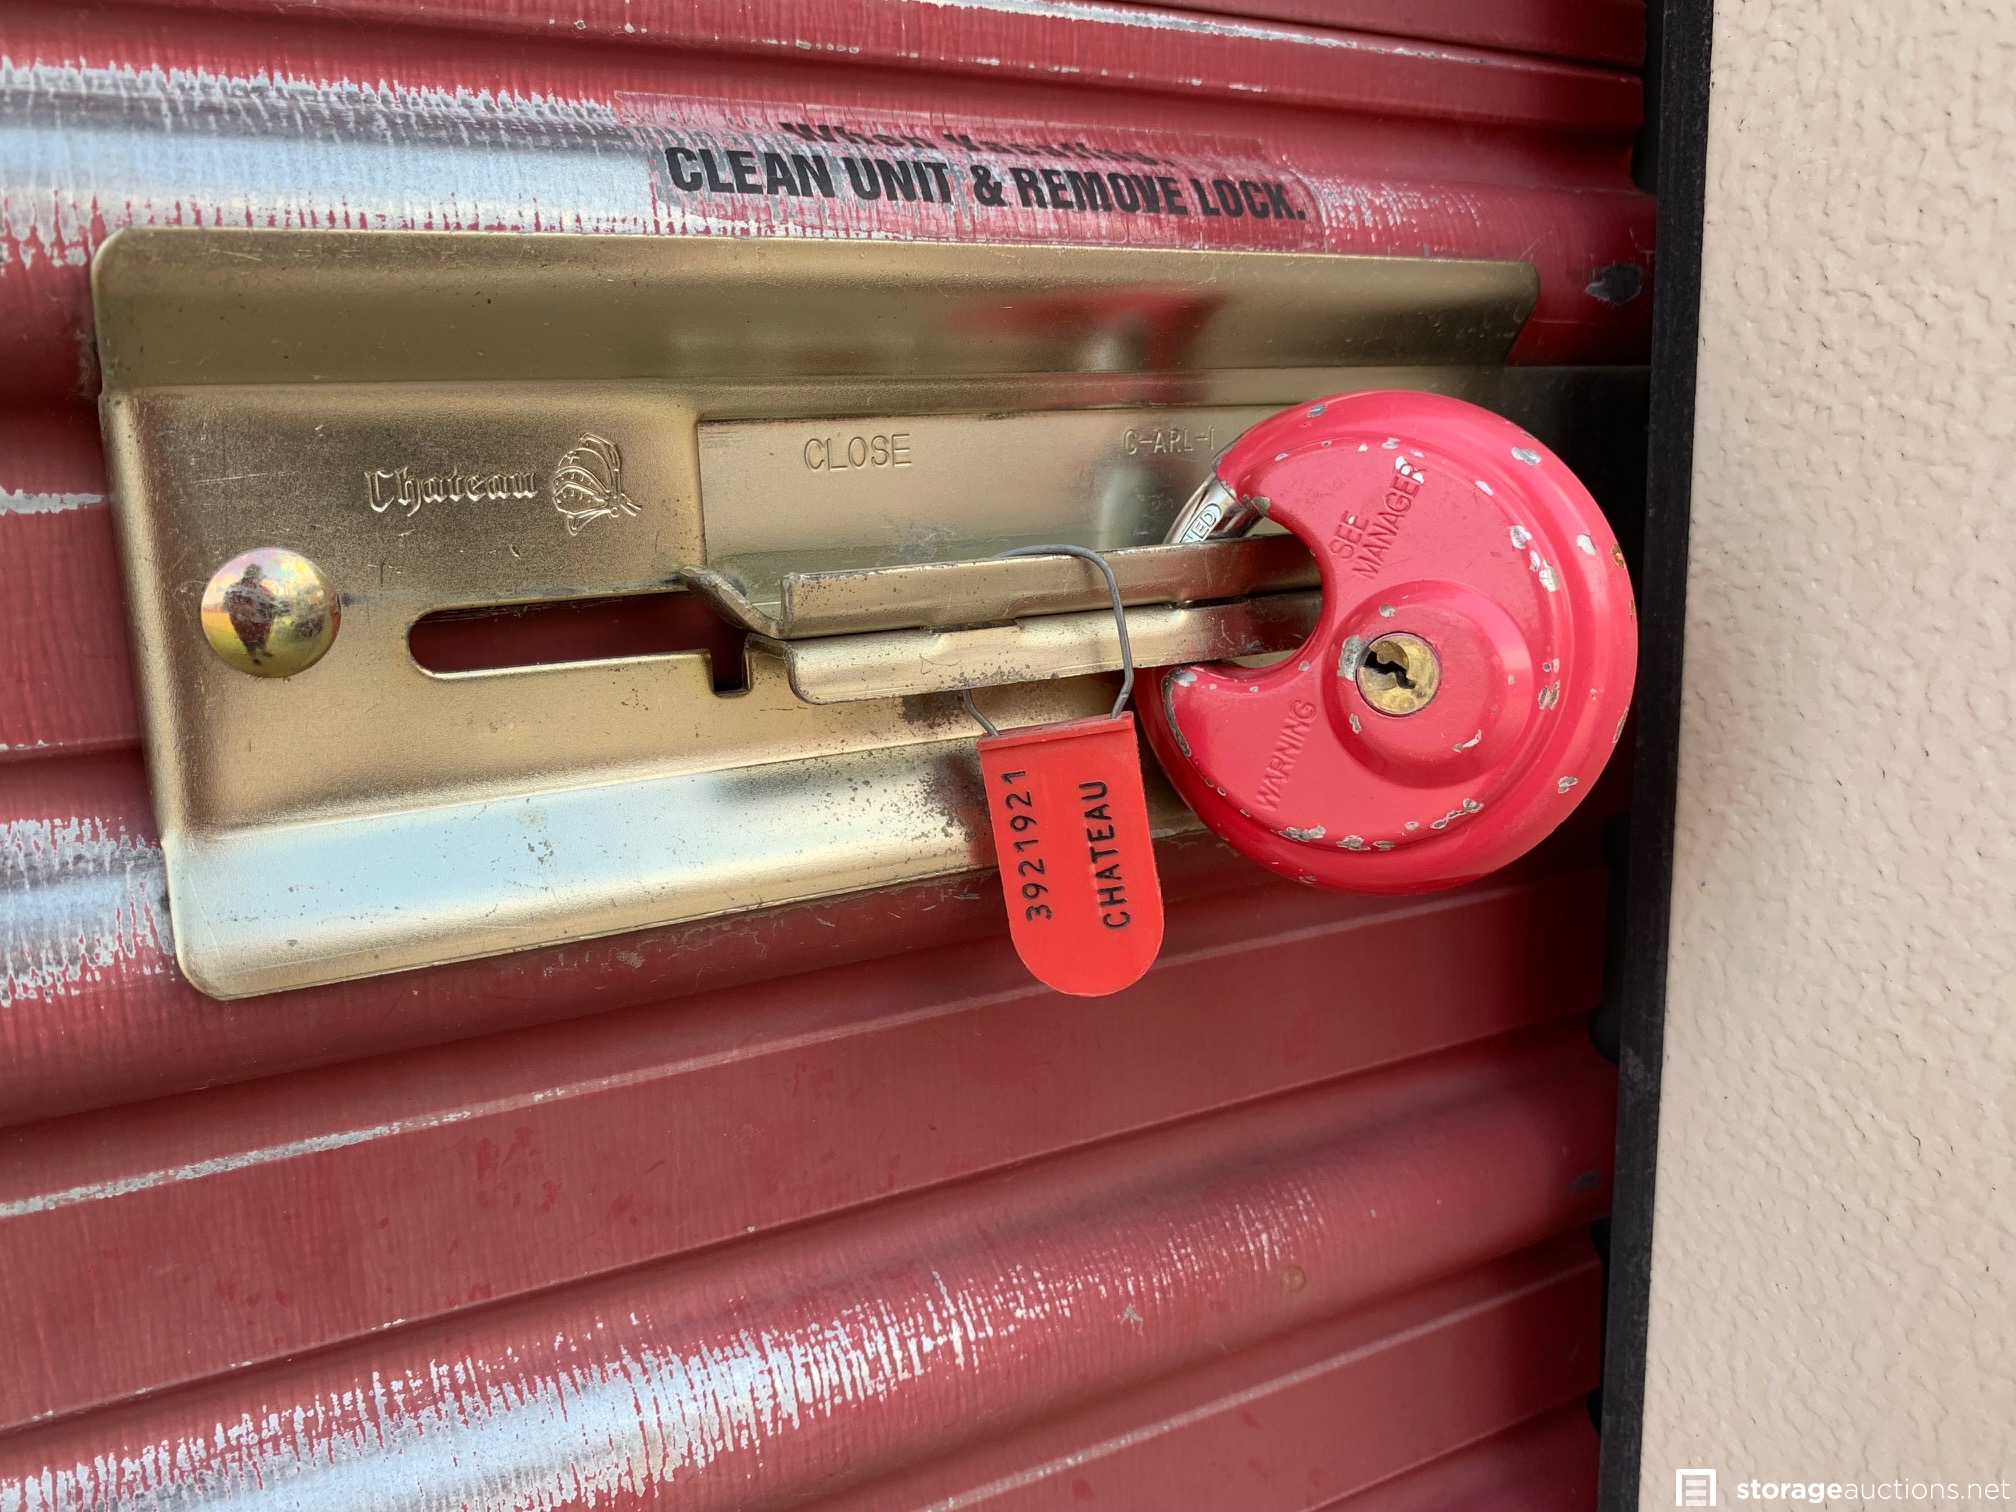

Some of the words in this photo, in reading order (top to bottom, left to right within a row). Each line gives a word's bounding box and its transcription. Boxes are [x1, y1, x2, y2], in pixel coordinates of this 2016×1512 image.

[664, 147, 835, 200] CLEAN
[844, 157, 955, 204] UNIT
[973, 167, 1010, 208] &
[1017, 168, 1187, 216] REMOVE
[1198, 179, 1306, 221] LOCK.
[364, 466, 539, 518] Chateau
[803, 433, 912, 472] CLOSE
[1328, 510, 1370, 560] SEE
[1350, 456, 1426, 580] MANAGER
[1254, 701, 1317, 812] WARNING
[1001, 771, 1052, 921] 3921921
[1078, 781, 1131, 930] CHATEAU
